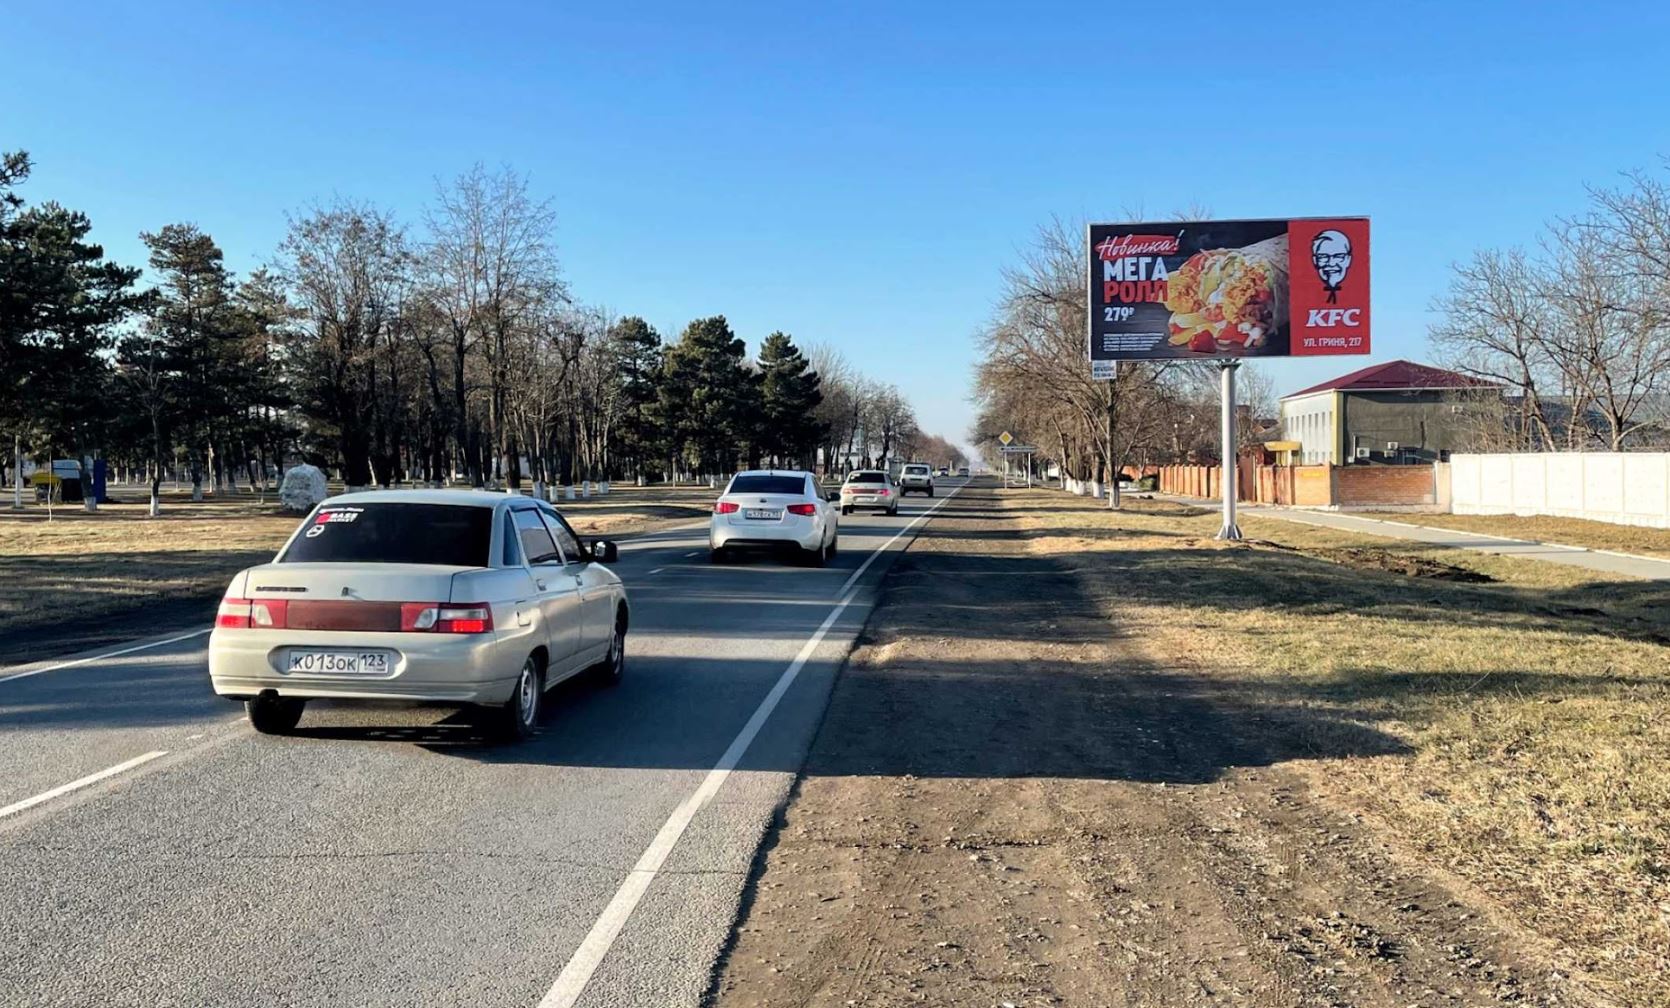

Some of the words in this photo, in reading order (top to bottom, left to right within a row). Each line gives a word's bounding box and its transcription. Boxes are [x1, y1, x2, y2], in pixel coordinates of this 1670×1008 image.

[1098, 229, 1185, 260] Новинка!
[1104, 257, 1169, 282] МЕГА
[1104, 280, 1169, 303] РОЛЛ
[1306, 308, 1361, 327] KFC
[1303, 337, 1317, 347] УЛ.
[361, 654, 385, 667] 123
